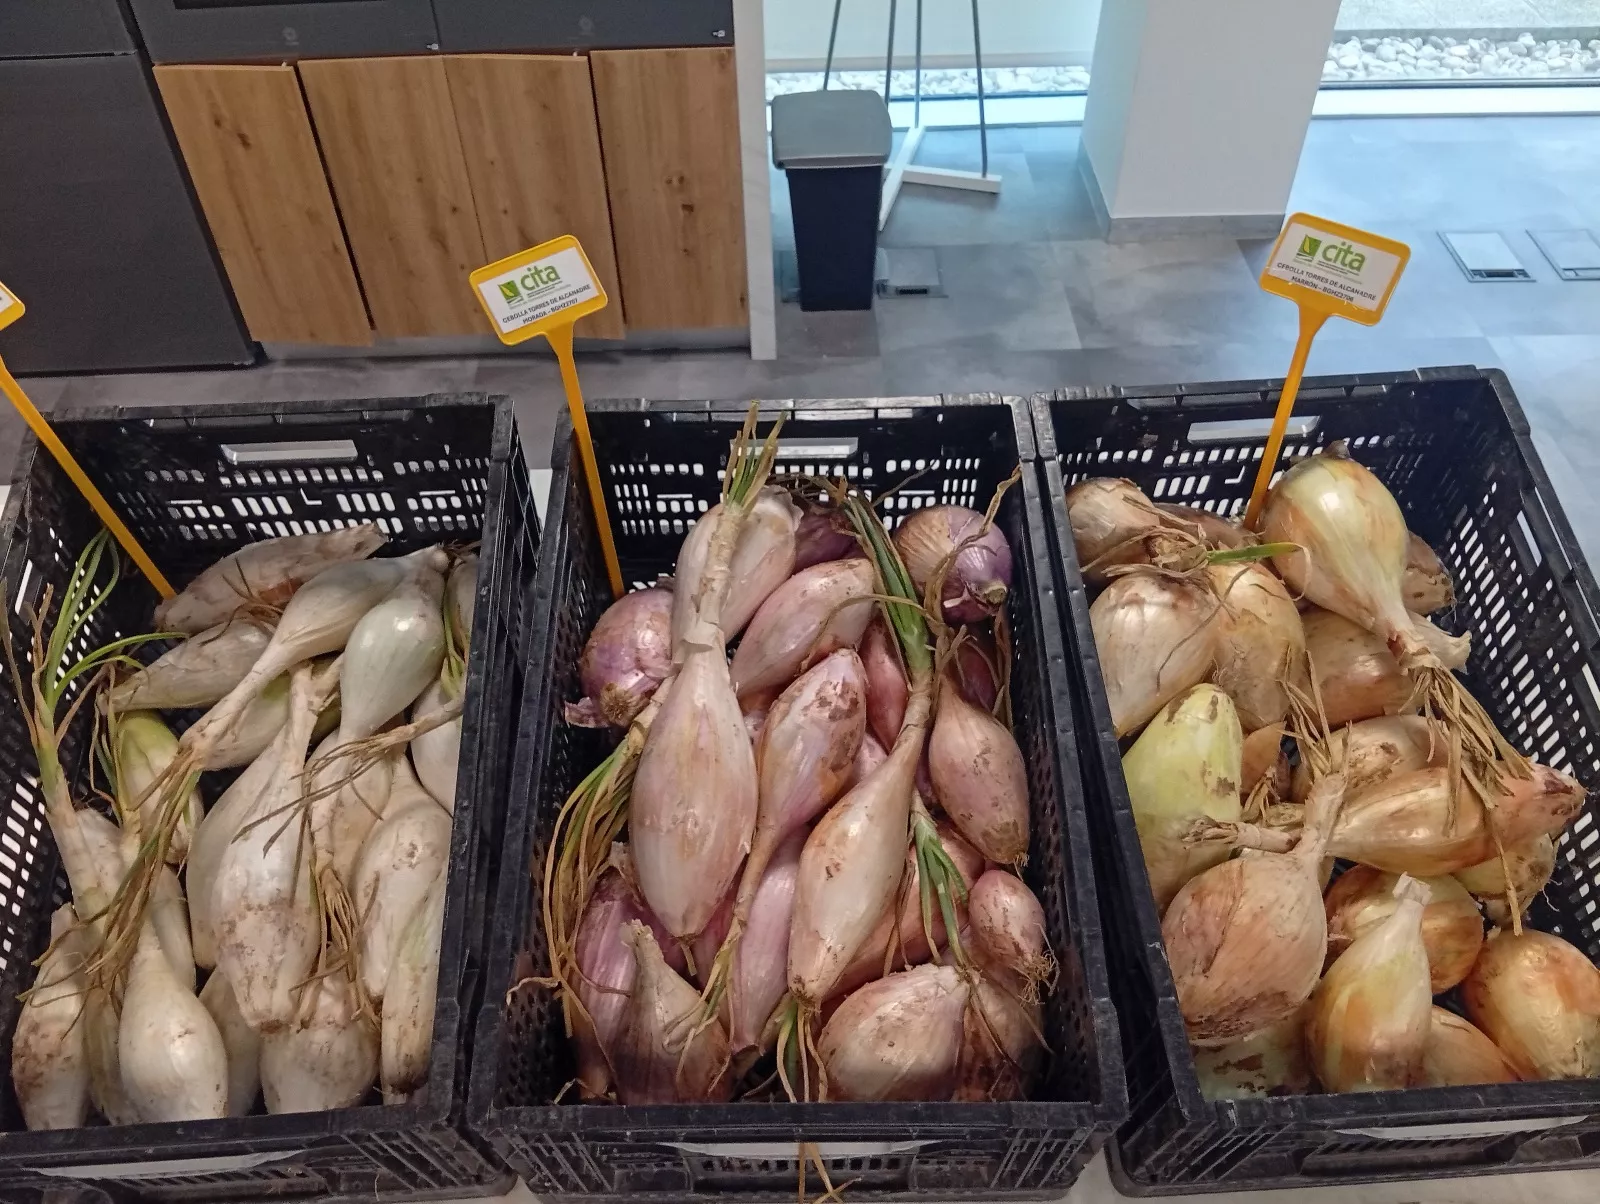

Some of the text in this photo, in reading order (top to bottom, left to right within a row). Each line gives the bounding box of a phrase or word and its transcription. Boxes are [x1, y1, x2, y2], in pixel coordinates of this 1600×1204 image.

[1322, 241, 1366, 272] cita
[520, 265, 561, 291] cita
[1305, 271, 1329, 284] TORRES
[1330, 279, 1338, 287] DE
[1338, 281, 1376, 301] ALCANADRE
[502, 310, 527, 324] CEBOLLA
[528, 301, 550, 316] TORRES
[549, 297, 558, 307] DE
[557, 284, 591, 303] ALCANADRE
[522, 311, 547, 324] MORADA
